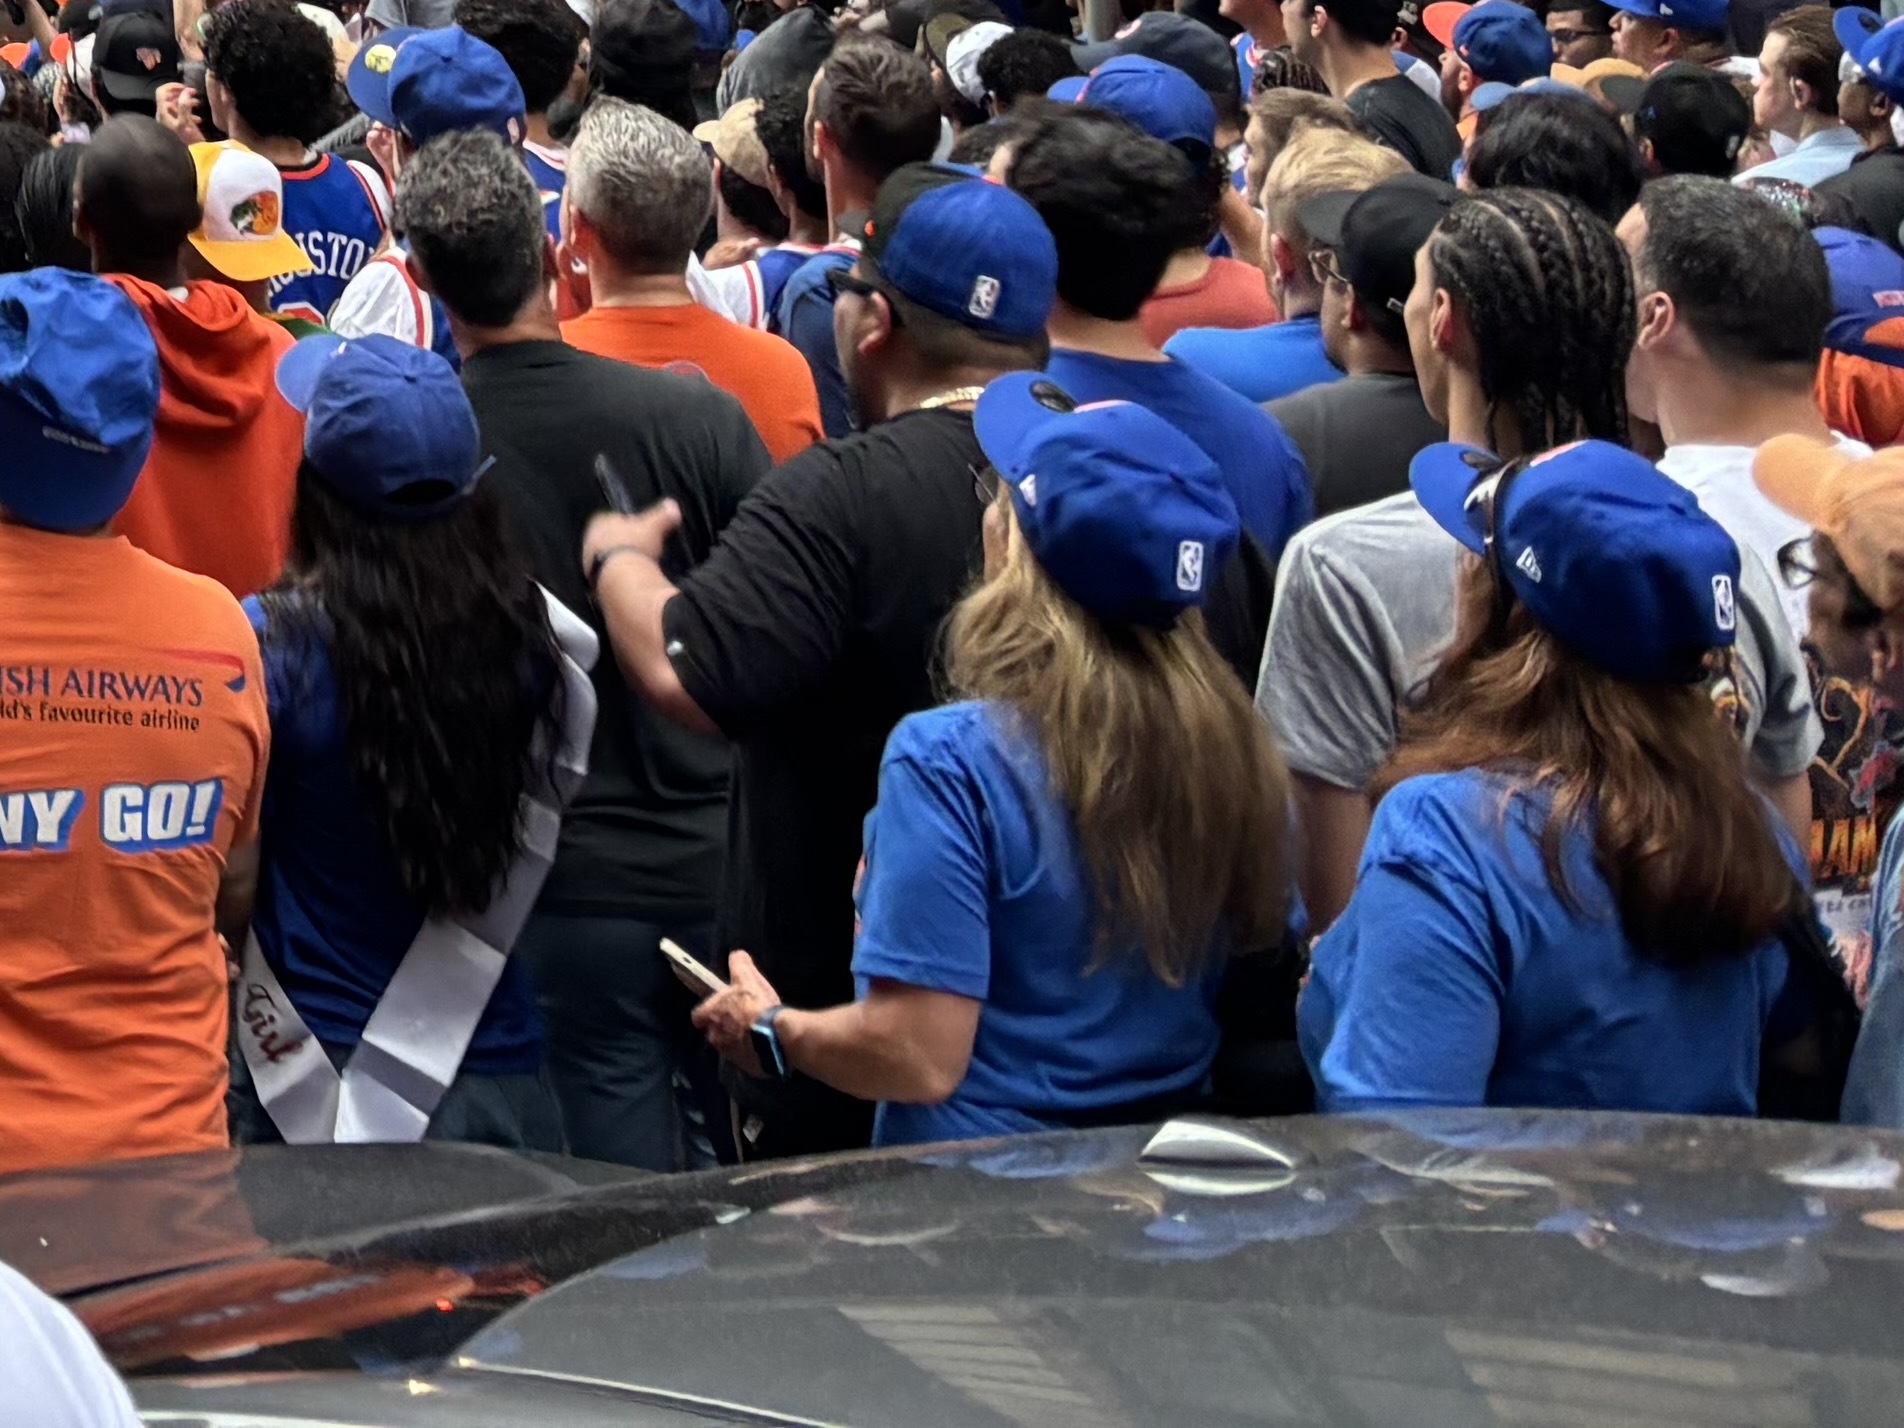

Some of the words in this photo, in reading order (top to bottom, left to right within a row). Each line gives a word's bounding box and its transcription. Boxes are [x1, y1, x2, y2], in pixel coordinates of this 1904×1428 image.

[61, 667, 202, 707] AIRWAYS
[40, 699, 132, 726] favourite
[141, 707, 200, 732] airline
[102, 781, 219, 846] GO!
